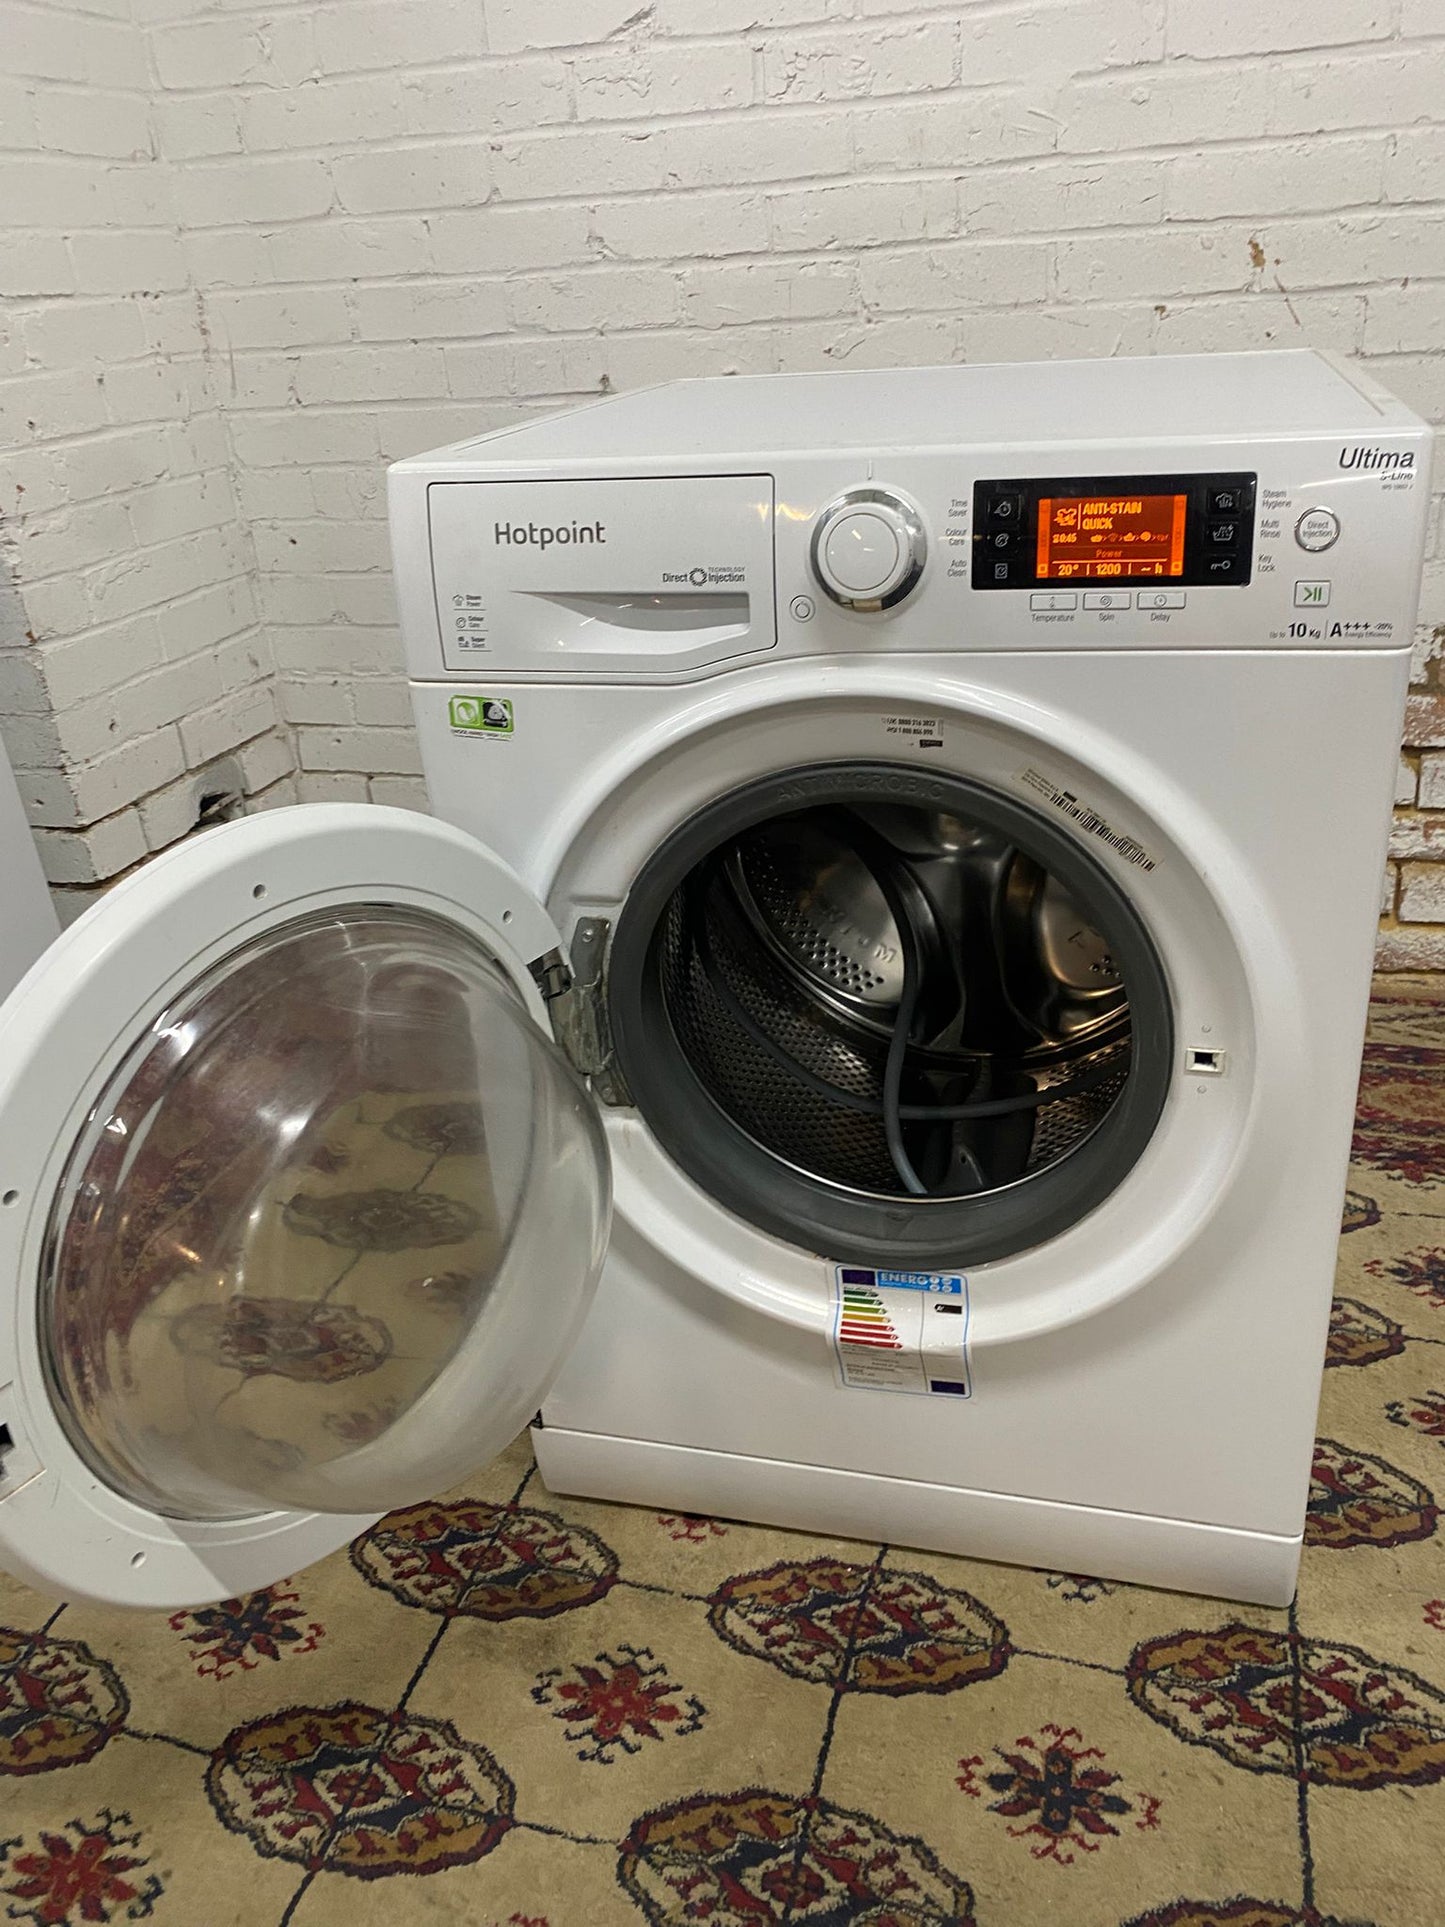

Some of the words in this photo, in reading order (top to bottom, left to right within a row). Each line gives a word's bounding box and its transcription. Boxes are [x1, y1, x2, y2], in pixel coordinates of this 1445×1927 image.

[1338, 447, 1415, 470] Ultima
[1262, 489, 1287, 498] Steam
[951, 499, 968, 508] Time
[1082, 501, 1142, 515] ANTI-STAIN
[1262, 499, 1292, 510] Hygiene
[947, 508, 968, 517] Saver
[1082, 516, 1113, 530] QUICK
[1261, 519, 1280, 528] Multi
[1307, 520, 1329, 529] Direct
[494, 520, 607, 551] Hotpoint
[945, 528, 968, 537] Colour
[1260, 529, 1281, 538] Rinse
[1302, 530, 1333, 539] Injection
[948, 538, 965, 546] Care
[1095, 549, 1123, 558] Power
[1258, 553, 1273, 564] Key
[950, 559, 968, 567] Auto
[1257, 562, 1277, 573] Lock
[946, 568, 968, 577] Clean
[1058, 563, 1080, 576] 20°
[1096, 562, 1122, 575] 1200
[662, 572, 688, 583] Direct
[708, 572, 746, 584] Injection
[1031, 612, 1075, 623] Temperature
[1099, 612, 1115, 622] Spin
[1150, 612, 1172, 622] Delay
[1288, 622, 1307, 638] 10
[1329, 621, 1371, 638] A+++
[880, 1270, 929, 1285] ENERG
